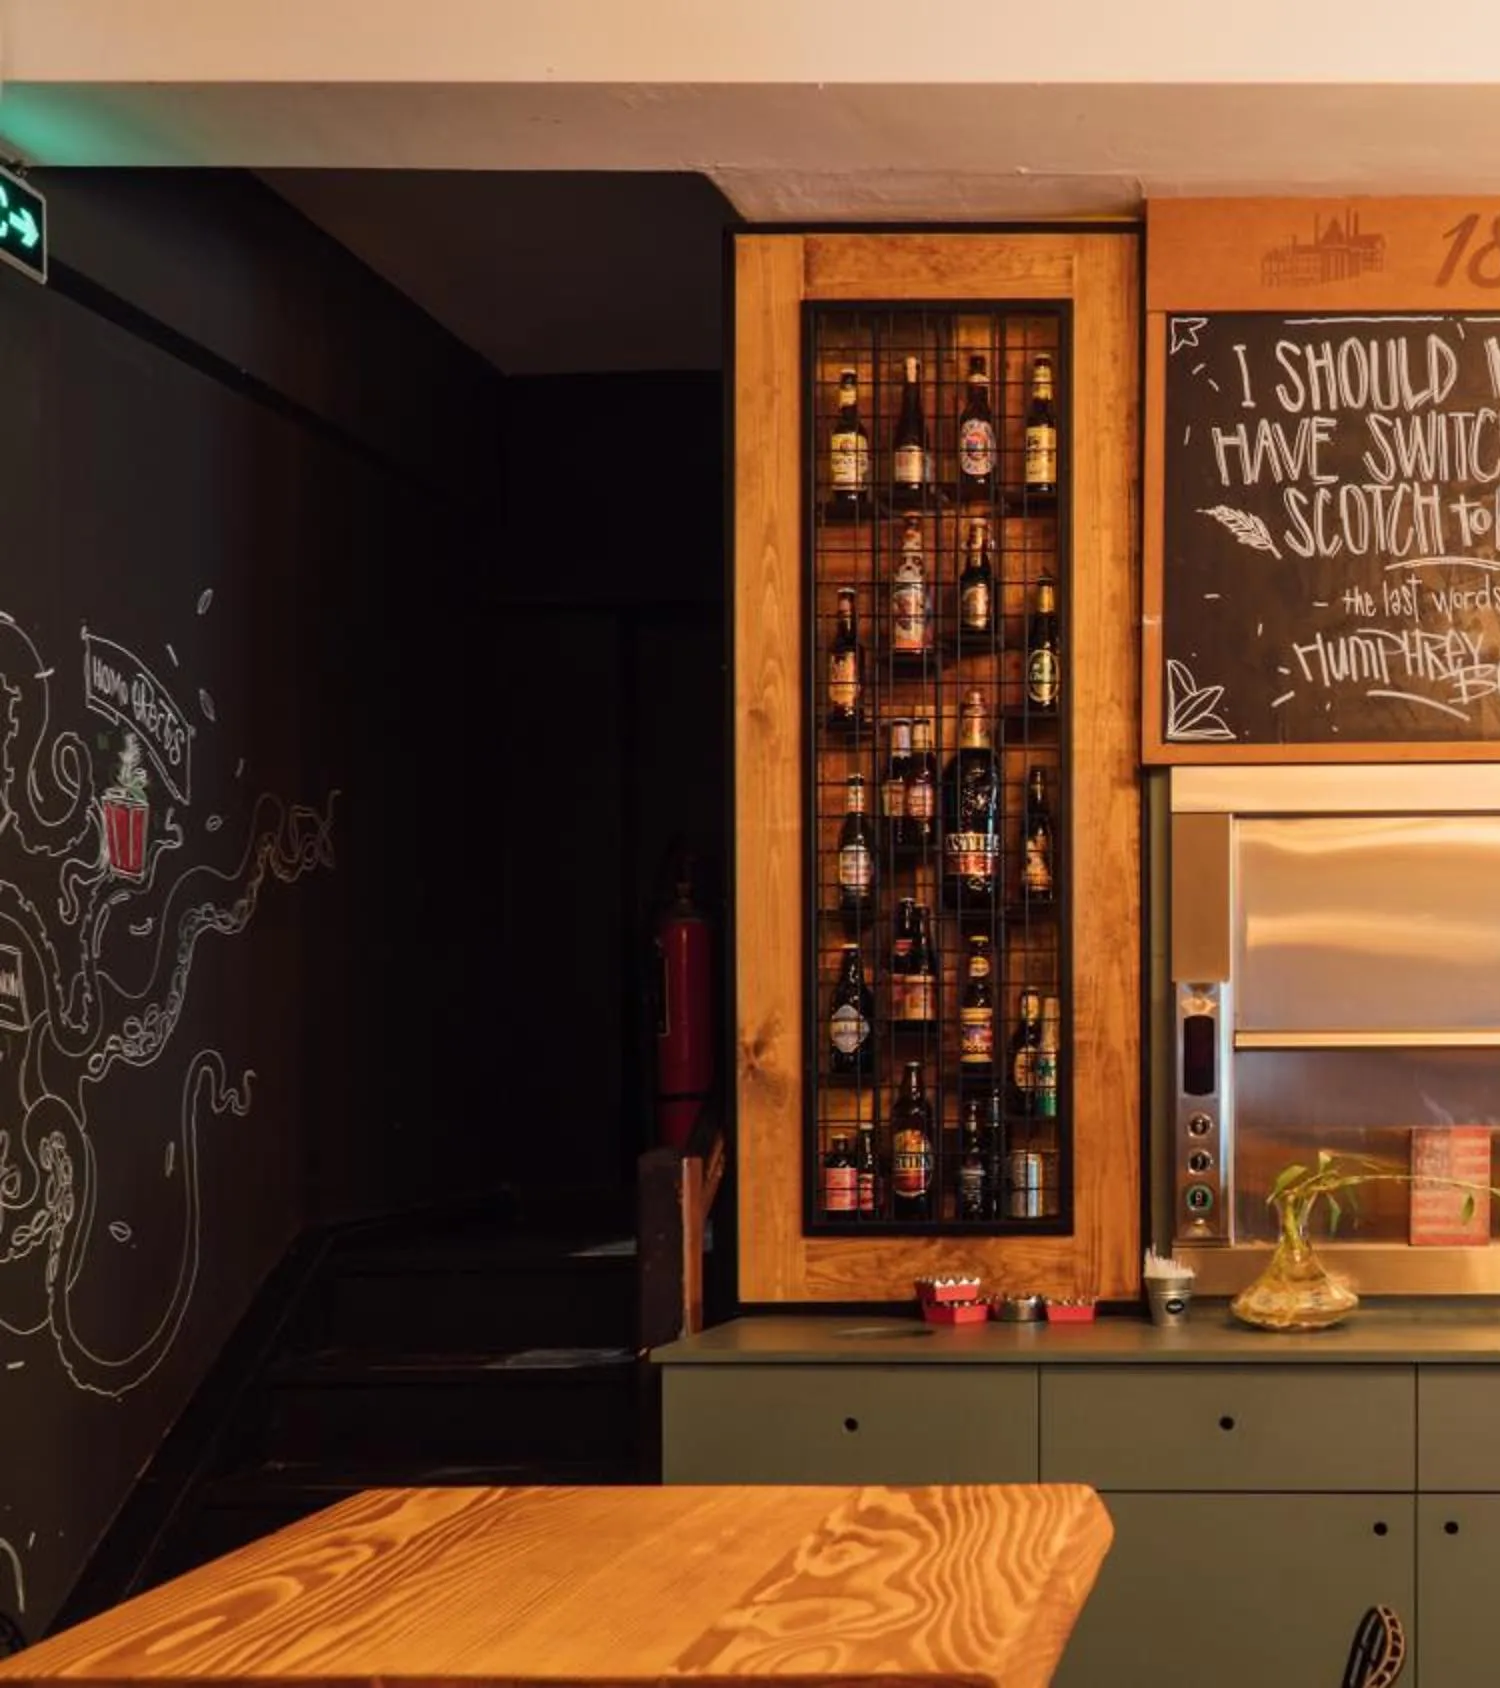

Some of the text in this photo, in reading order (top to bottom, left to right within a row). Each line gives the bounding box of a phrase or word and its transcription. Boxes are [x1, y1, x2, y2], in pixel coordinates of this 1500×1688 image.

[1232, 344, 1256, 408] I
[1274, 334, 1458, 412] SHOULD
[1211, 417, 1339, 485] HAVE
[1283, 480, 1445, 558] SCOTCH
[1449, 500, 1492, 547] to
[1342, 585, 1377, 617] the
[1382, 574, 1423, 623] last
